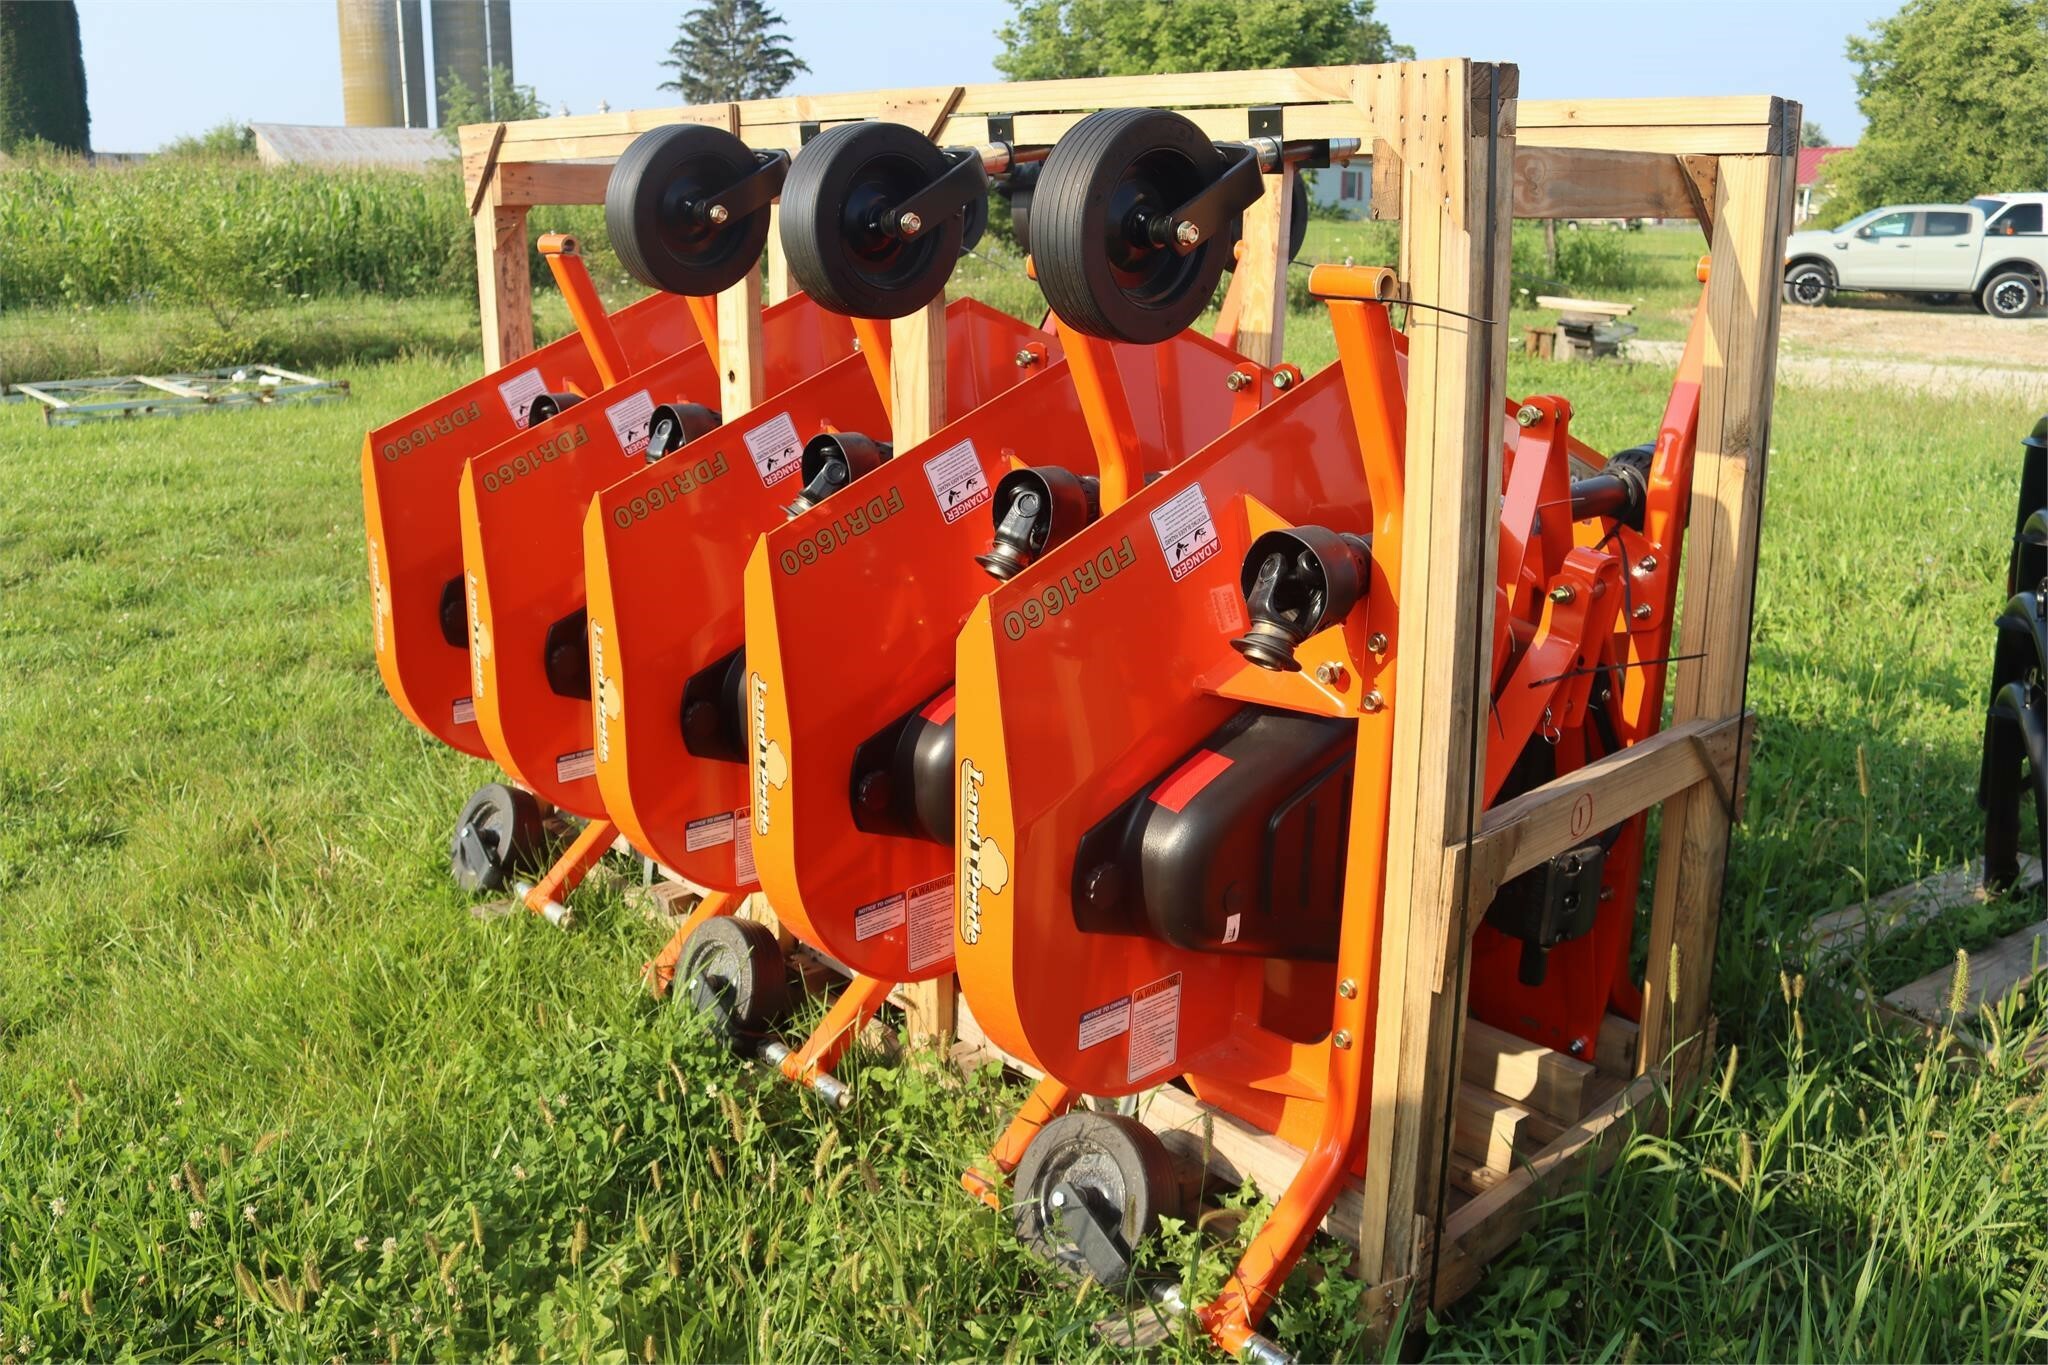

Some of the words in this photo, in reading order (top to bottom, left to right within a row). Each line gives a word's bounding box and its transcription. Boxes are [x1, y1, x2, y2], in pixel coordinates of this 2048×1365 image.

[383, 401, 482, 462] FDR1660
[482, 423, 589, 493] FDR1660
[613, 450, 729, 529] FDR1660
[764, 460, 801, 485] DANGER
[946, 495, 984, 520] DANGER
[780, 486, 905, 576] FDR1660
[1173, 547, 1213, 579] DANGER
[1003, 535, 1137, 641] FDR1660
[752, 673, 768, 744] Land
[756, 758, 770, 836] Pride
[964, 760, 985, 848] Land
[918, 878, 952, 895] WARNING
[964, 858, 983, 945] Pride
[1144, 976, 1177, 998] WARNING
